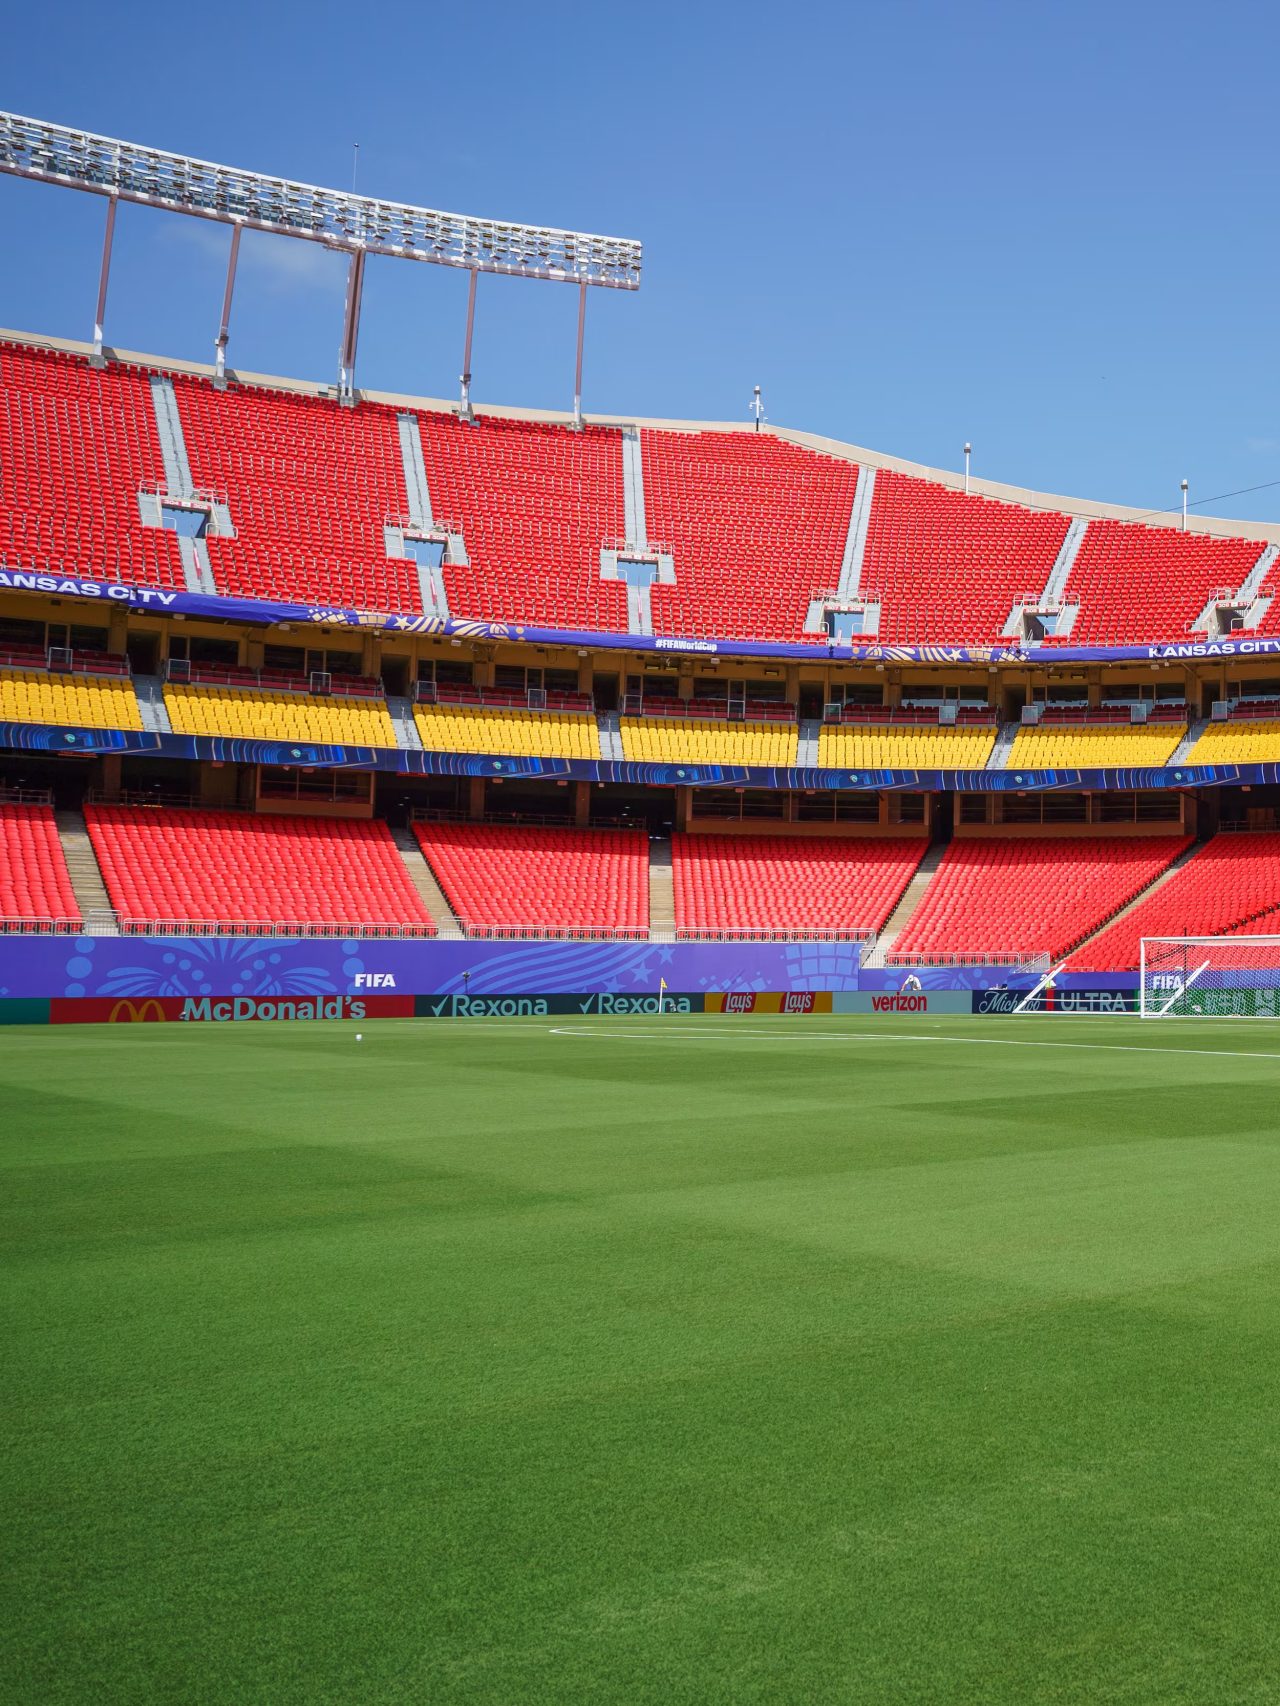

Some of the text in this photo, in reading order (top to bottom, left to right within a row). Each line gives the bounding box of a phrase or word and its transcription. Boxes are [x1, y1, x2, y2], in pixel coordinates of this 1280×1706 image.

[107, 586, 177, 605] CITY
[655, 638, 718, 652] #FIFAWorldCup
[1148, 643, 1236, 658] KANSAS
[354, 973, 396, 988] FIFA
[1152, 975, 1183, 990] FIFA
[182, 995, 367, 1021] McDonald's
[452, 994, 548, 1017] Rexona
[598, 992, 691, 1014] Rexona
[725, 991, 754, 1014] Lay's
[783, 991, 812, 1014] Lay's
[872, 992, 928, 1012] verizon
[1060, 992, 1127, 1012] ULTRA
